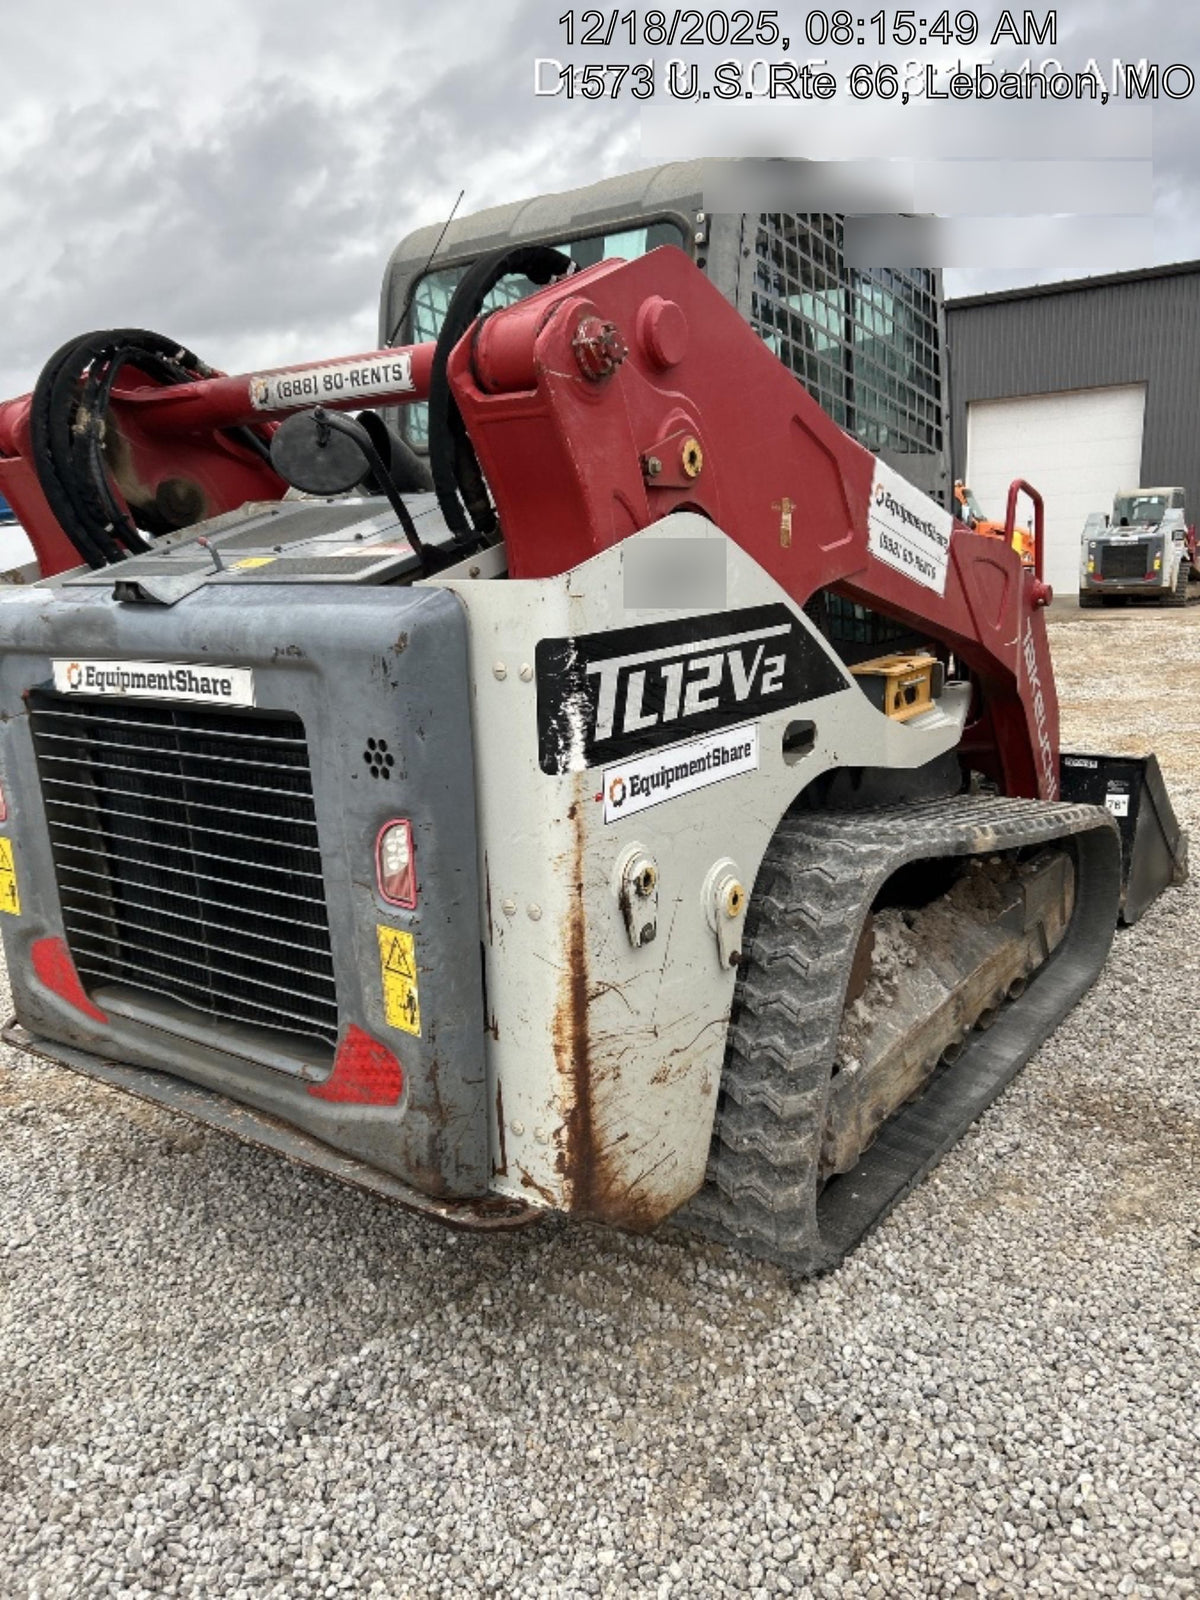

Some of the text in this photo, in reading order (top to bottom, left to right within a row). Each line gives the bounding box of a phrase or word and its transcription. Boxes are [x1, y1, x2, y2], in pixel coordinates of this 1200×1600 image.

[277, 363, 403, 399] (888) 80-RENTS
[85, 666, 232, 696] EquipmentShare
[586, 623, 792, 743] TL12V2
[628, 741, 752, 799] EquipmentShare
